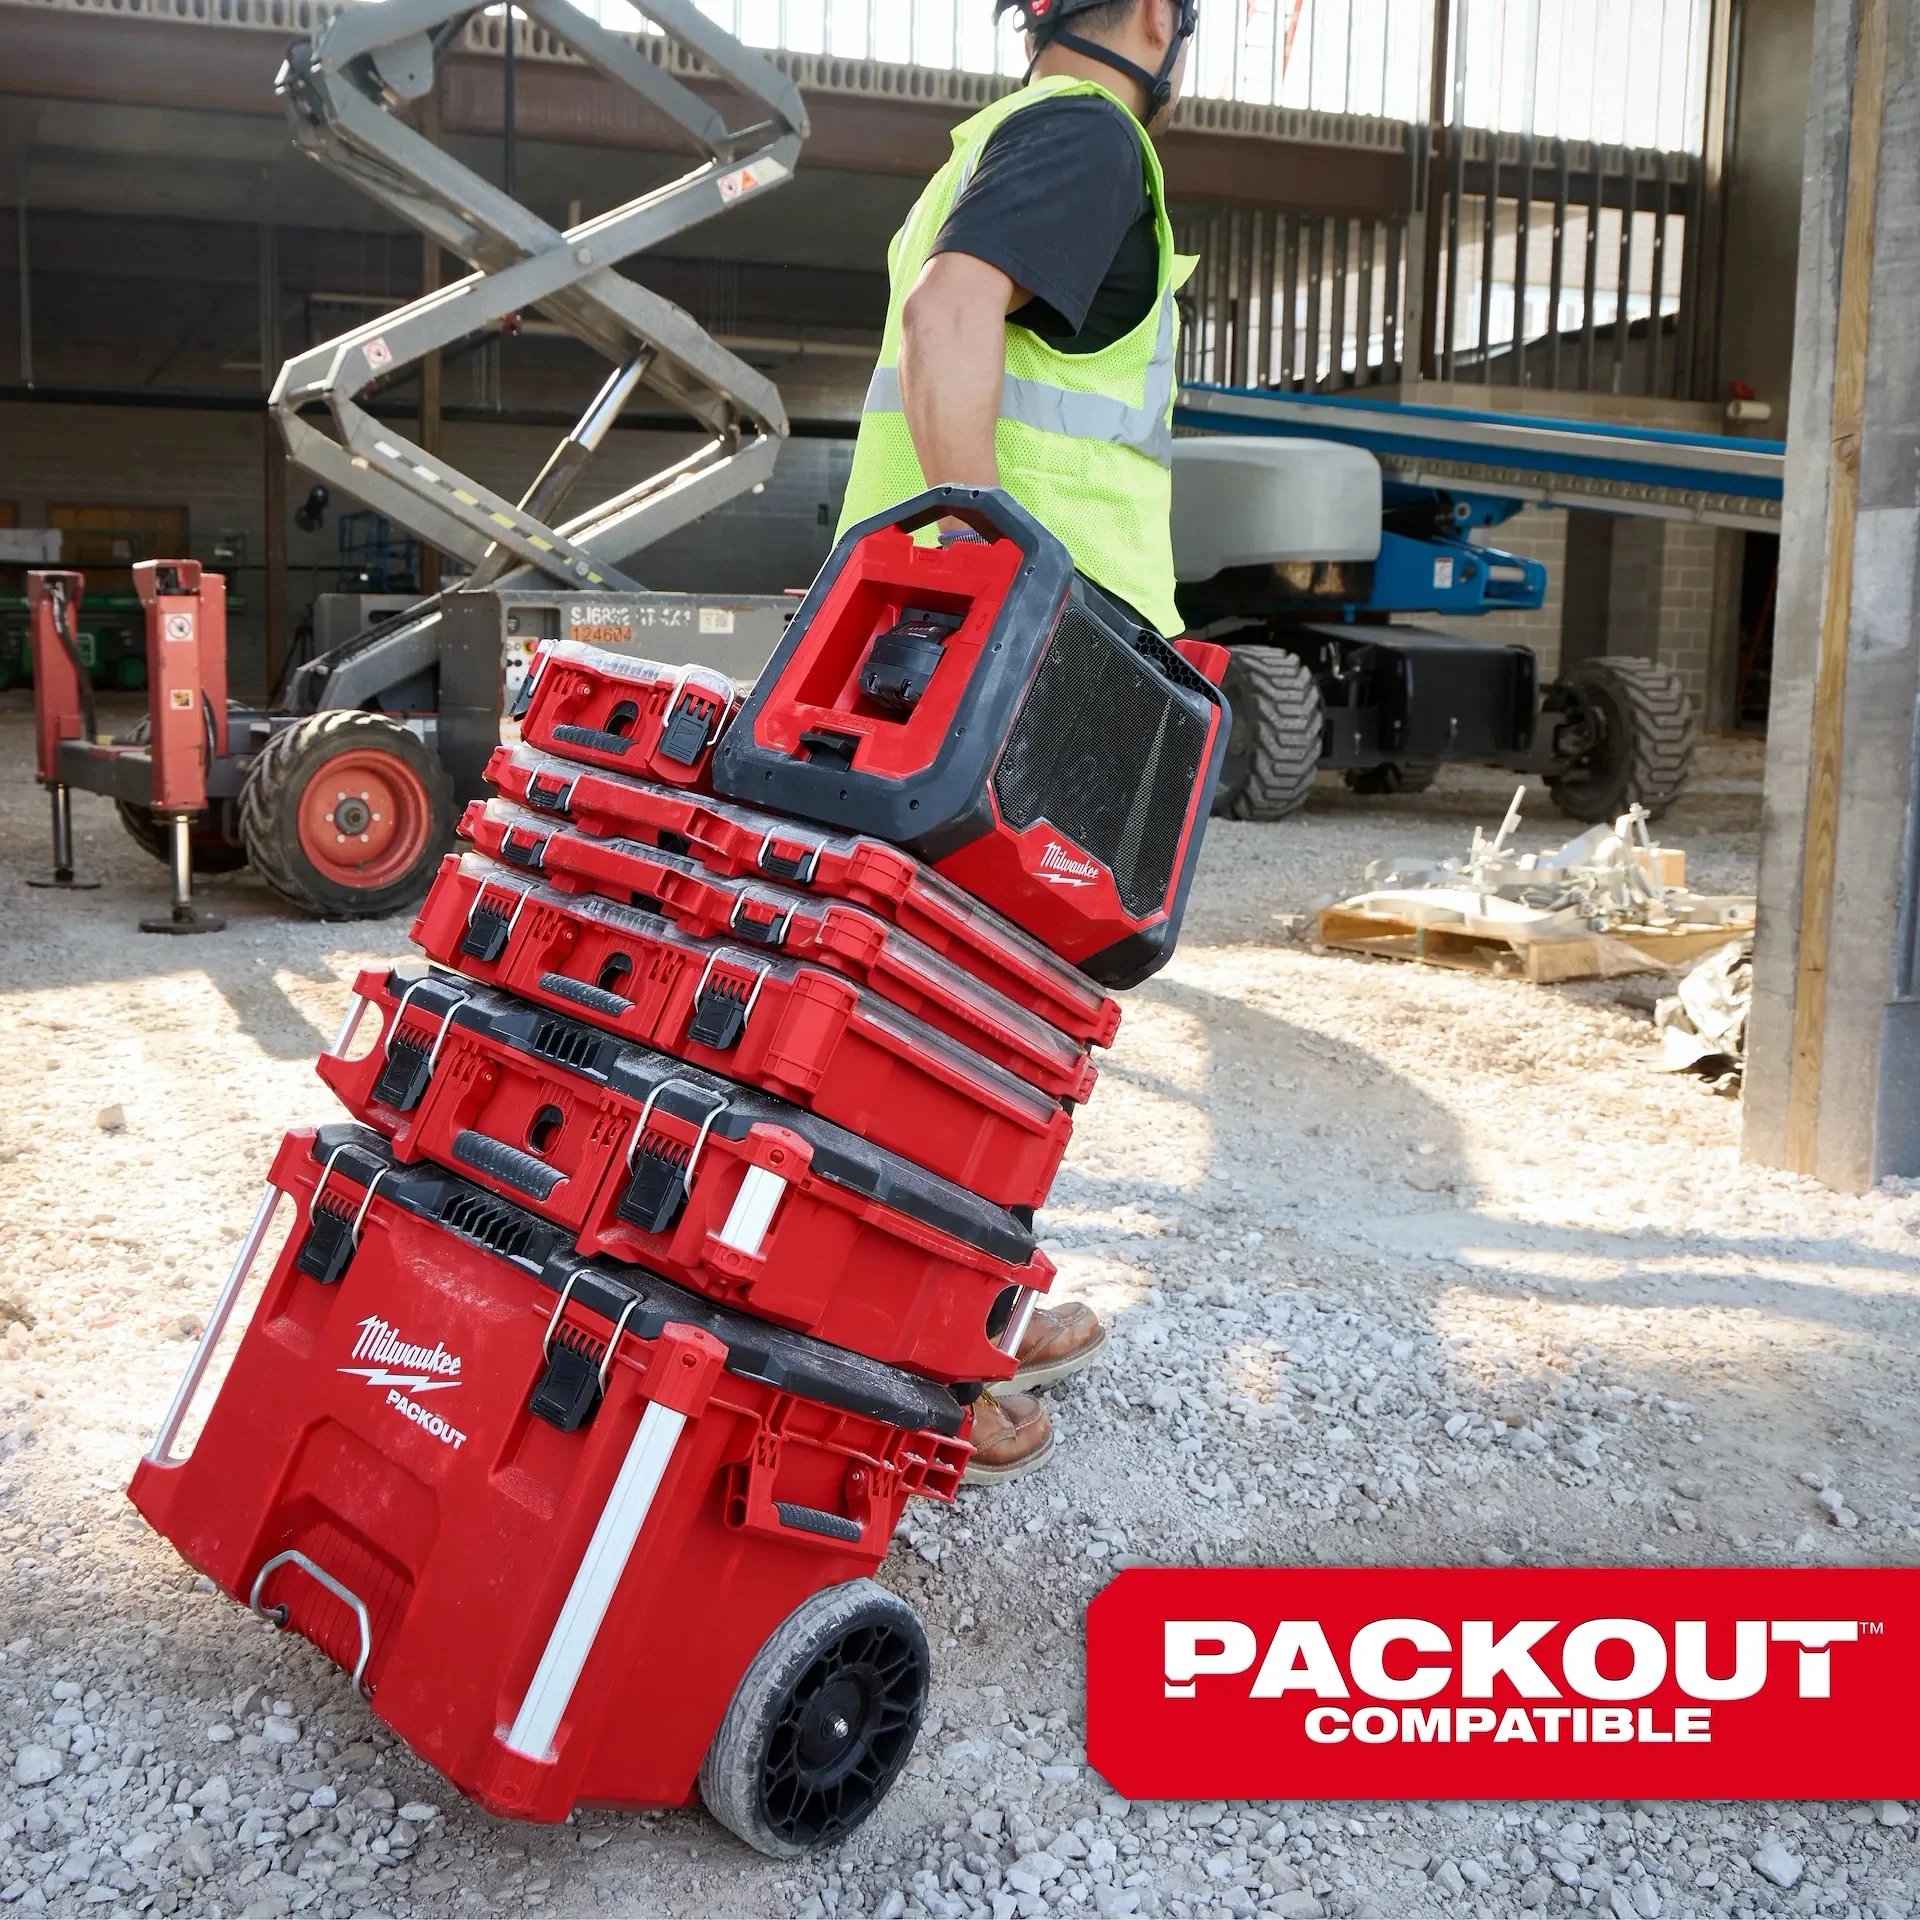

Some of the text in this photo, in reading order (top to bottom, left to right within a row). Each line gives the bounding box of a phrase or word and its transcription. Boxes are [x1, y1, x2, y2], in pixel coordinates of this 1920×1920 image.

[573, 626, 633, 641] 124604
[1040, 841, 1099, 879] Milwaukee
[351, 1314, 462, 1376] Milwaukee
[385, 1388, 467, 1450] PACKOUT
